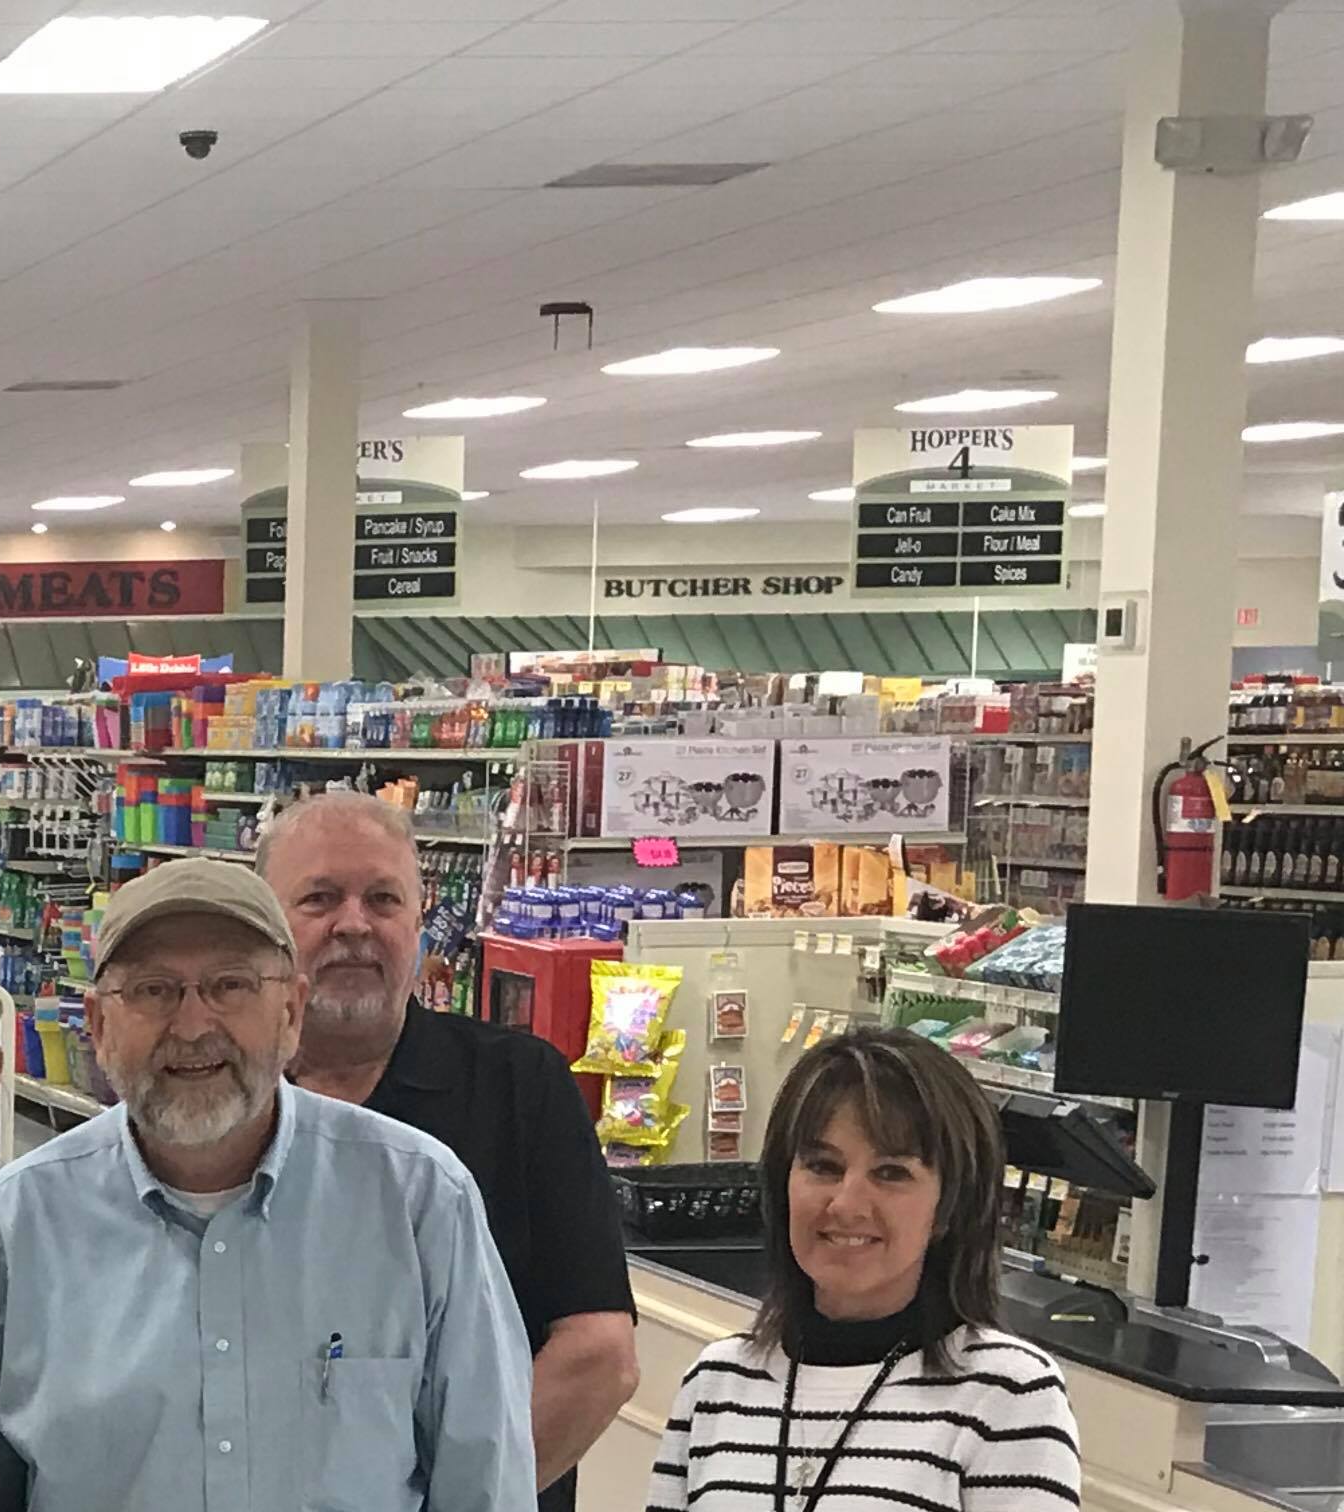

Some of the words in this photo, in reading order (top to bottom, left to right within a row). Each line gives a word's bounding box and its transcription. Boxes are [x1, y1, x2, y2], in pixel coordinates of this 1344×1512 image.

[911, 428, 1013, 452] HOPPER'S
[947, 446, 976, 478] 4
[925, 482, 996, 491] MARKET
[886, 507, 907, 524] Can
[910, 506, 931, 523] Fruit
[990, 505, 1016, 522] Cake
[1018, 505, 1036, 521] Mix
[364, 518, 407, 535] Pancake
[415, 517, 445, 537] Syrup
[984, 535, 1009, 552] Flour
[1016, 534, 1041, 552] Meal
[370, 548, 394, 565] Fruit
[401, 547, 438, 564] Snacks
[890, 566, 924, 586] Candy
[993, 564, 1028, 583] Spices
[387, 577, 421, 594] Cereal
[604, 577, 752, 598] BUTCHER
[761, 575, 844, 596] SHOP
